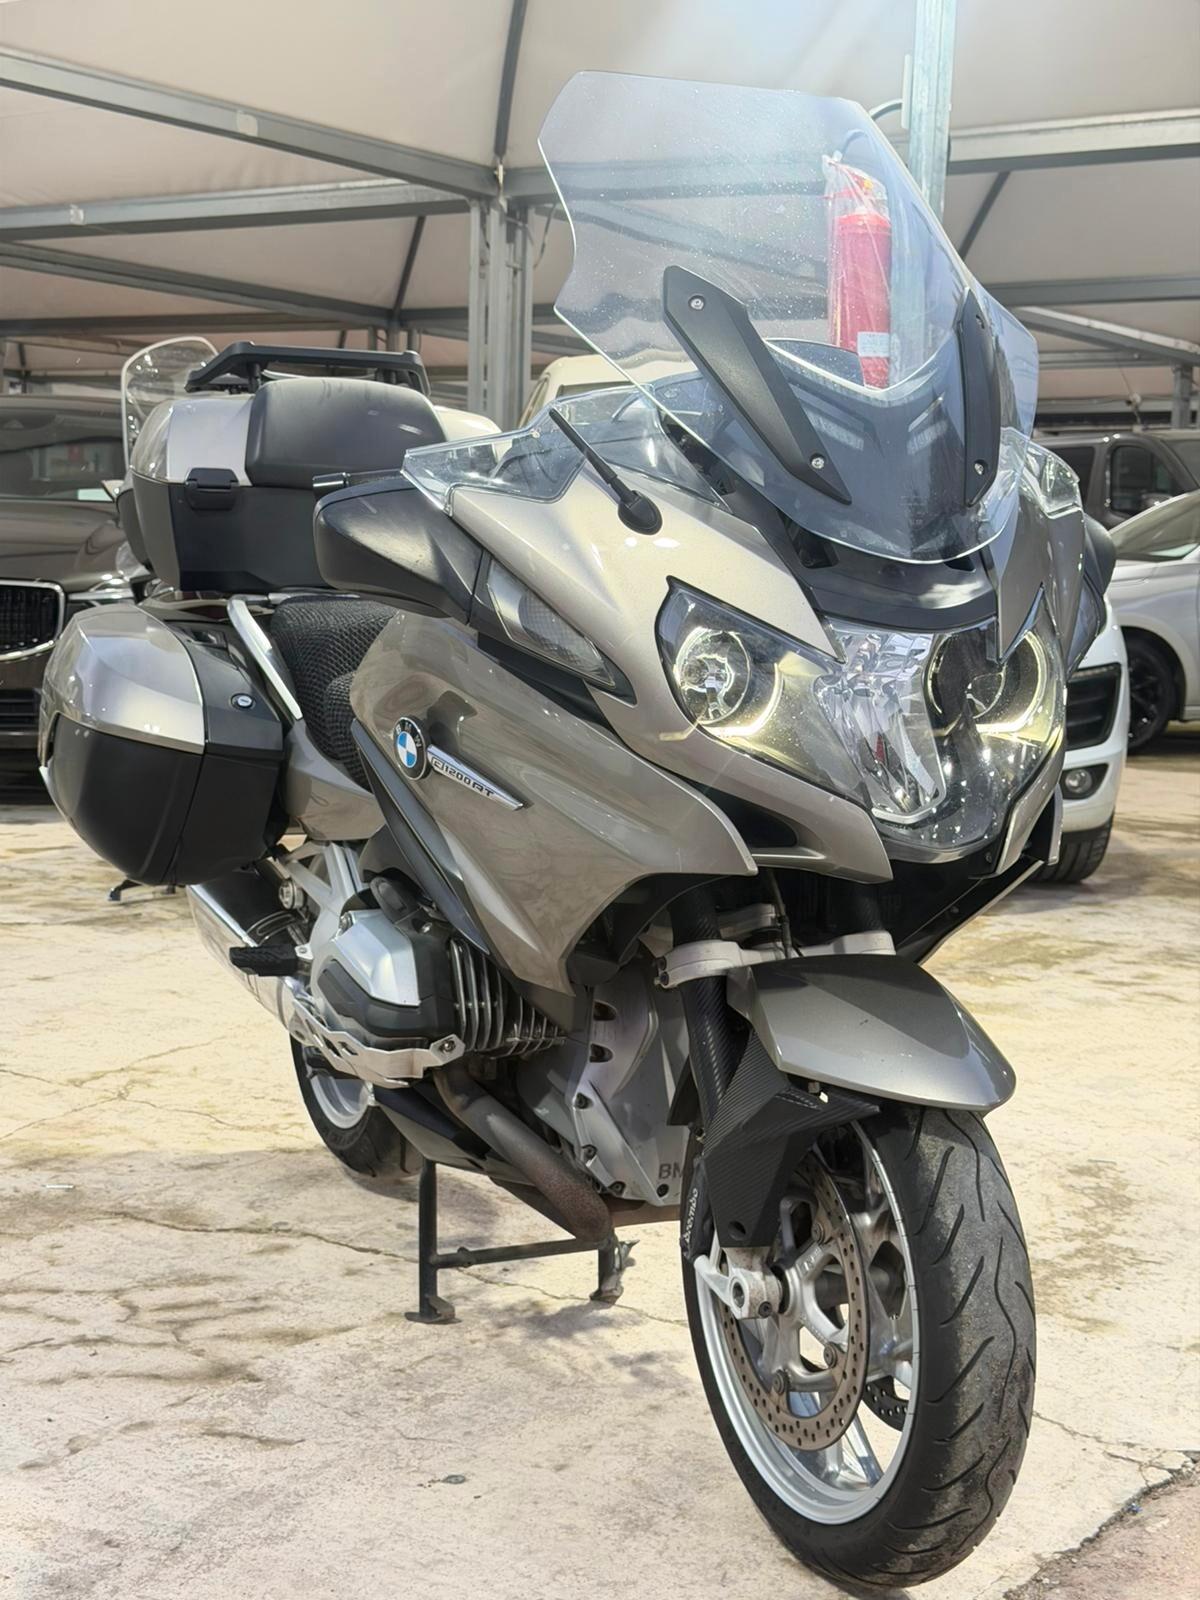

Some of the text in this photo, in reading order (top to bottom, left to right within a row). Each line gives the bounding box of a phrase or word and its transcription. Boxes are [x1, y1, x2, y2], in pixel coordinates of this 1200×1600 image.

[395, 721, 422, 748] BMW
[658, 1162, 684, 1179] BM
[683, 1187, 699, 1244] brembo
